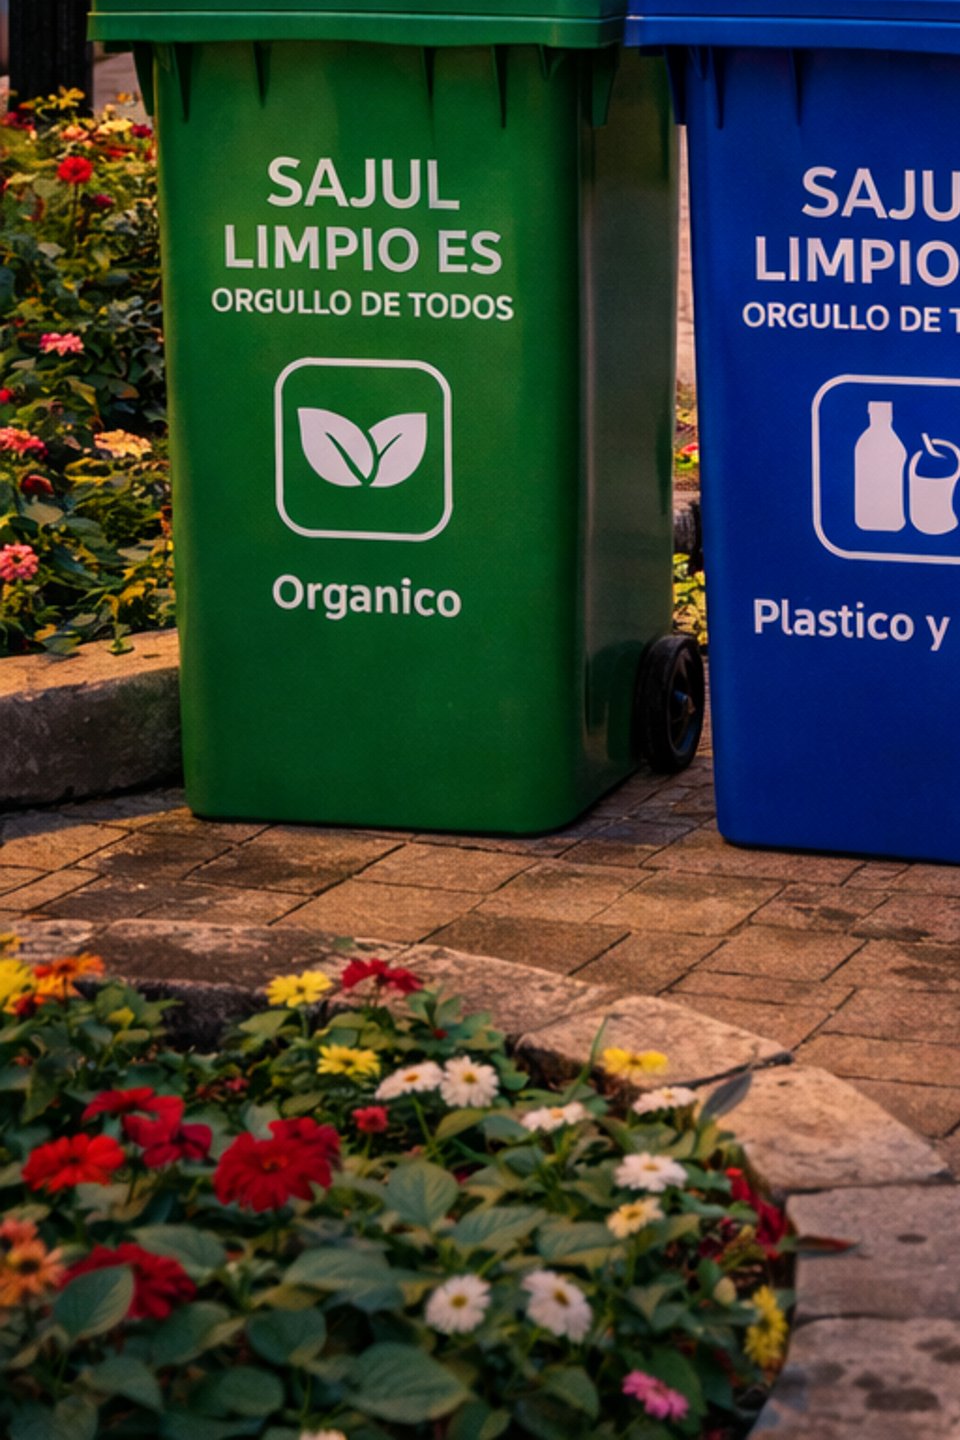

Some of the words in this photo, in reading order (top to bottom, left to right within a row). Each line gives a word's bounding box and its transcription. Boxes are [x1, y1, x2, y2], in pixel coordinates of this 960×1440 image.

[267, 156, 460, 210] SAJUL
[224, 224, 420, 273] LIMPIO
[438, 229, 502, 275] ES
[755, 235, 960, 287] LIMPIO
[211, 287, 352, 316] ORGULLO
[361, 290, 401, 317] DE
[407, 292, 514, 321] TODOS
[742, 301, 890, 331] ORGULLO
[900, 305, 942, 333] DE
[272, 574, 462, 620] Organico
[754, 598, 914, 642] Plastico
[925, 615, 950, 652] y
